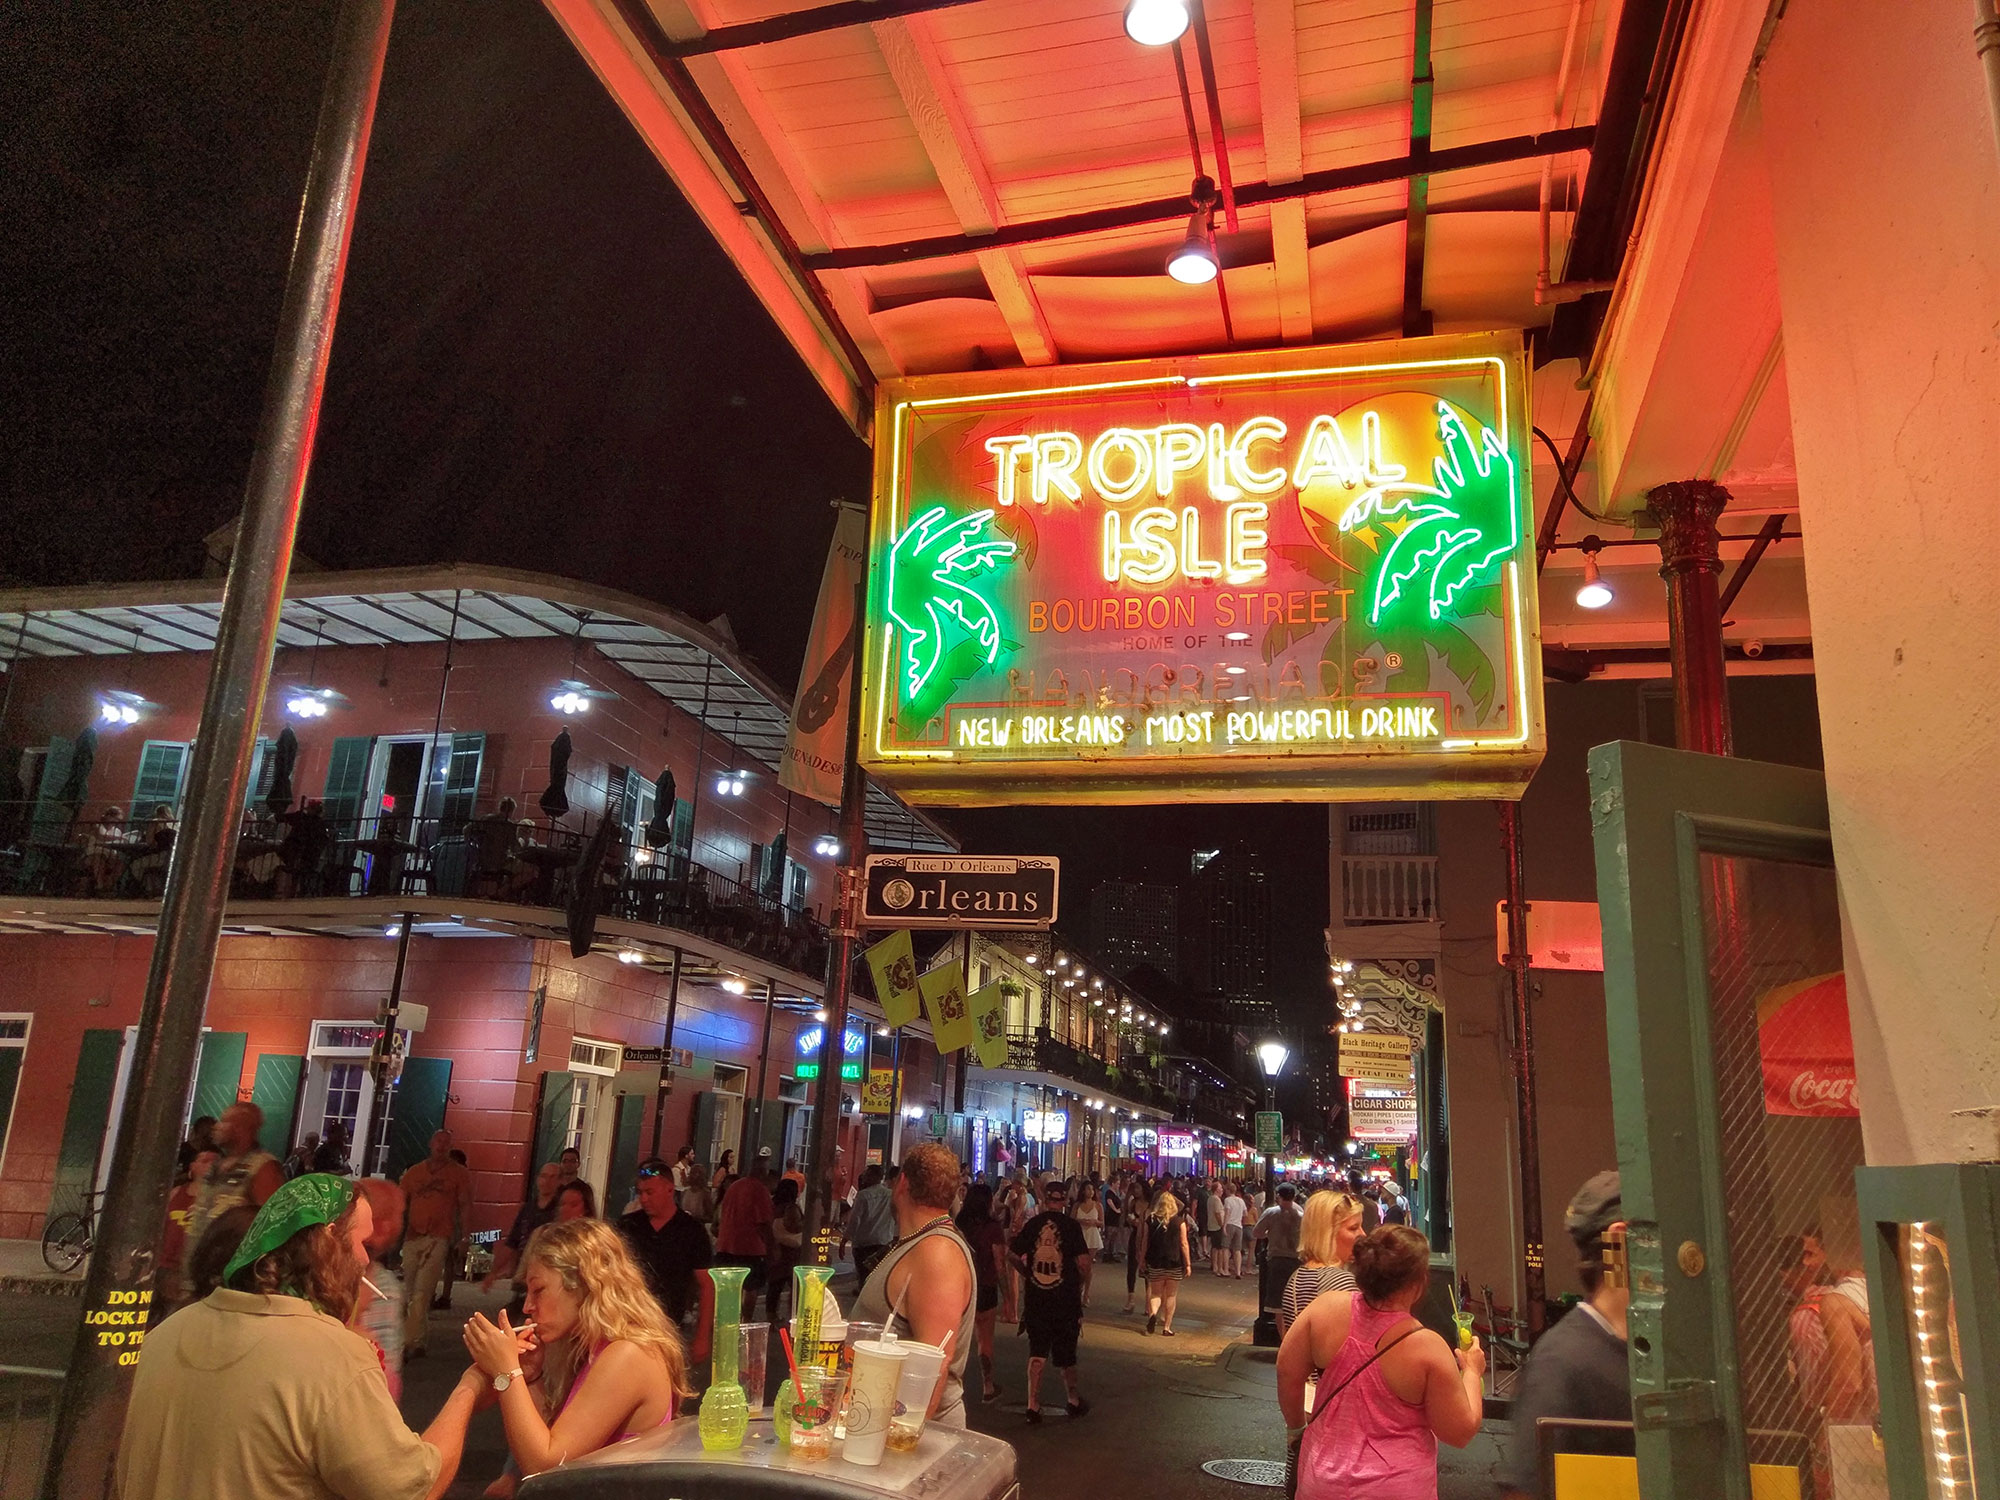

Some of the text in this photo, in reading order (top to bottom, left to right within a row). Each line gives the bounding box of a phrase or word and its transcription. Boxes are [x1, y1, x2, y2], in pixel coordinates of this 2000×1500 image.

[986, 411, 1406, 506] TROPICAL
[1104, 502, 1268, 583] ISLE
[1028, 589, 1355, 633] BOURBON STREET
[1123, 634, 1254, 650] HOME OF THE
[959, 706, 1439, 748] NEW ORLEANS MOST POWERFUL DRINK
[912, 860, 937, 872] Rue
[882, 878, 1038, 912] Orleans
[1342, 1038, 1409, 1051] Black Heritage Gallery
[625, 1050, 659, 1060] Orleans
[1354, 1099, 1383, 1109] CIGAR
[107, 1291, 153, 1304] DO N
[85, 1310, 135, 1325] LOCK
[98, 1332, 125, 1346] TO
[801, 1314, 812, 1363] TROPICAL ISLE
